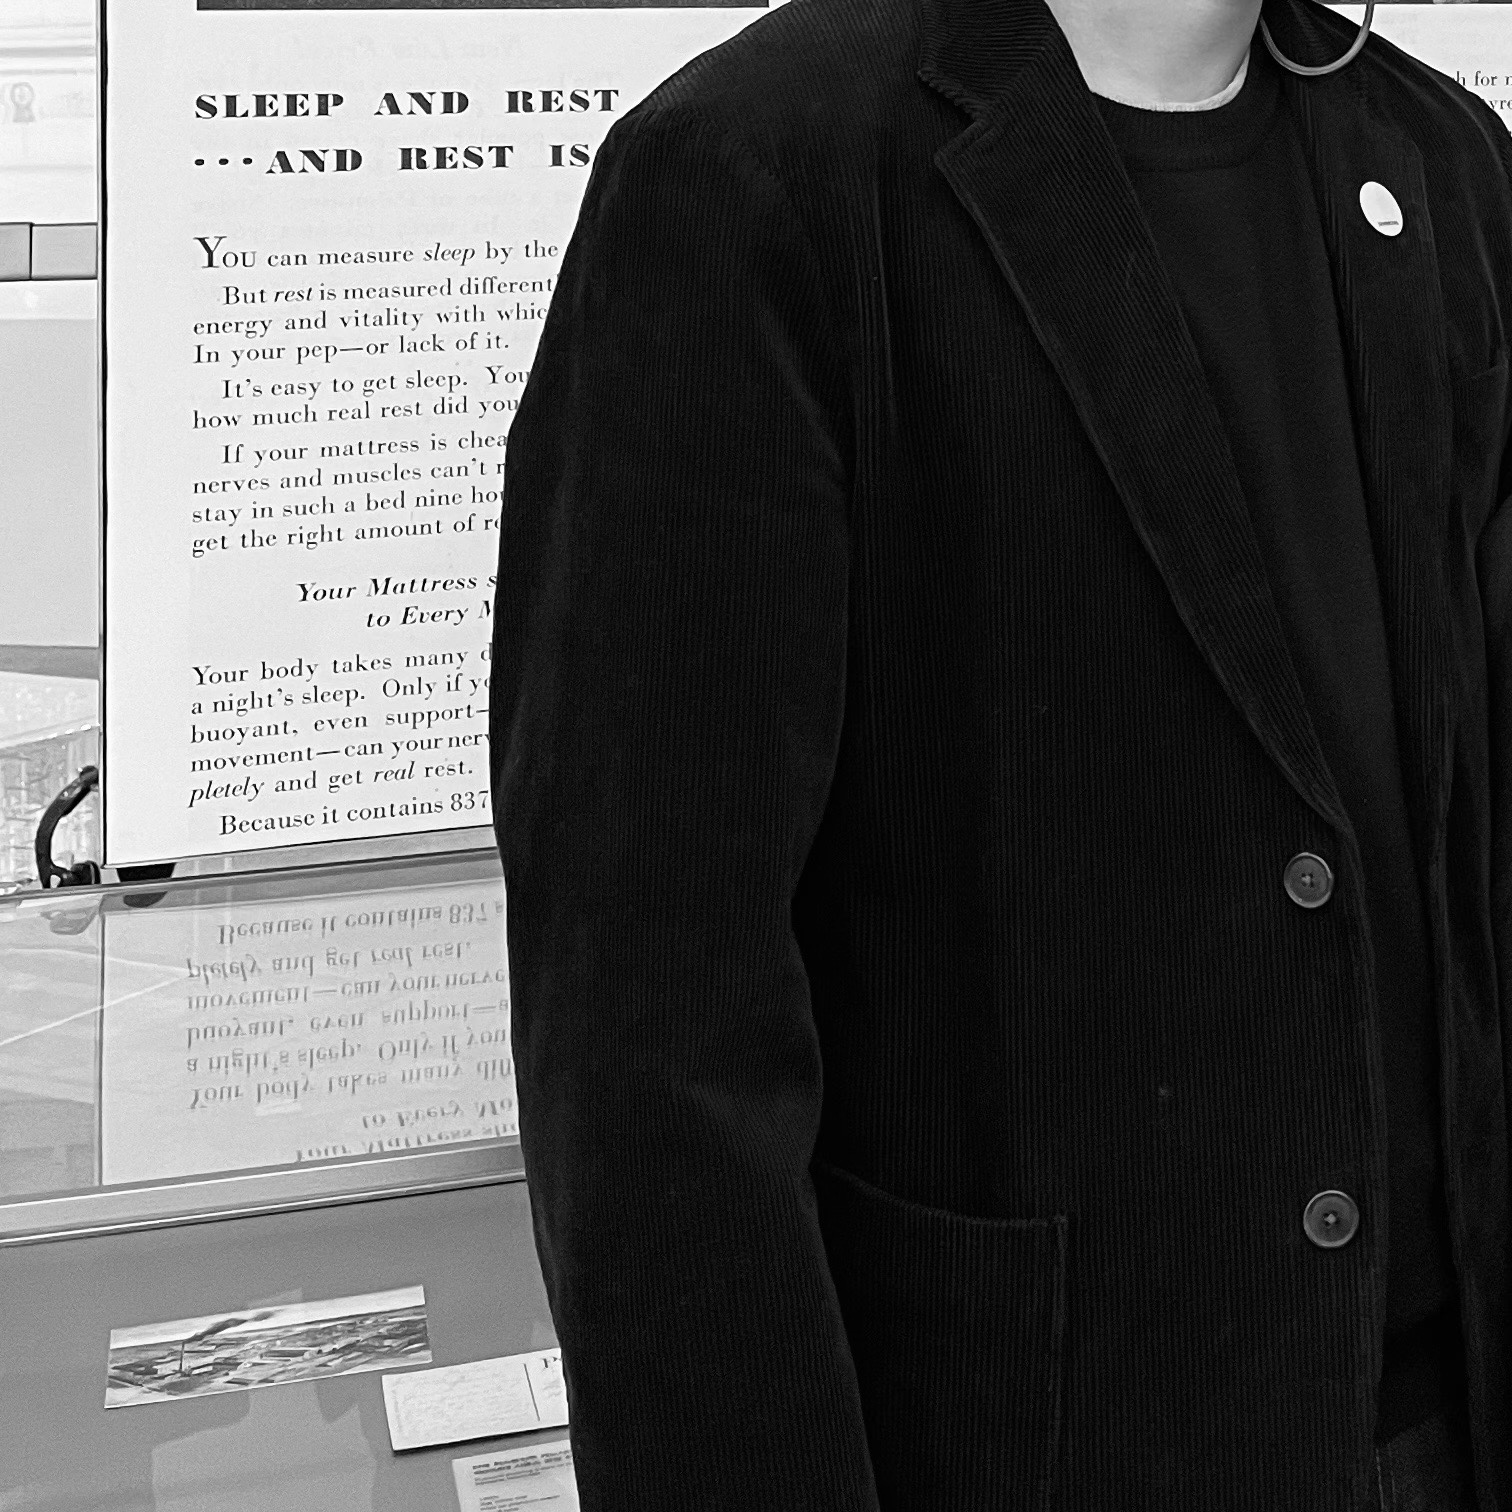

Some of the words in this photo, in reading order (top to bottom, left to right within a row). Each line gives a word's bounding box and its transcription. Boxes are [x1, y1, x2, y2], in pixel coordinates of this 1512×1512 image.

[1475, 71, 1497, 86] for
[195, 94, 343, 119] SLEEP
[374, 92, 469, 115] AND
[506, 90, 620, 113] REST
[399, 146, 513, 170] REST
[549, 144, 590, 167] IS
[194, 236, 256, 268] You
[268, 251, 307, 266] can
[319, 248, 413, 264] measure
[424, 243, 475, 266] sleep
[486, 241, 512, 264] by
[525, 240, 557, 258] the
[223, 287, 266, 304] But
[275, 286, 313, 302] rest
[320, 283, 336, 300] is
[345, 278, 451, 299] measured
[459, 272, 559, 296] different
[194, 319, 272, 338] energy
[285, 311, 326, 330] and
[340, 308, 423, 330] vitality
[437, 305, 484, 323] with
[496, 301, 547, 322] whic
[195, 345, 219, 363] In
[232, 347, 285, 367] your
[298, 341, 389, 364] pep—or
[400, 334, 445, 353] lack
[456, 332, 478, 350] of
[486, 332, 508, 348] it.
[189, 779, 264, 808] pletely
[275, 771, 316, 792] and
[329, 771, 362, 793] get
[374, 761, 415, 782] real
[425, 759, 472, 777] rest.
[219, 813, 314, 835] Because
[323, 806, 339, 824] it
[347, 797, 443, 821] contains
[451, 790, 488, 811] 837
